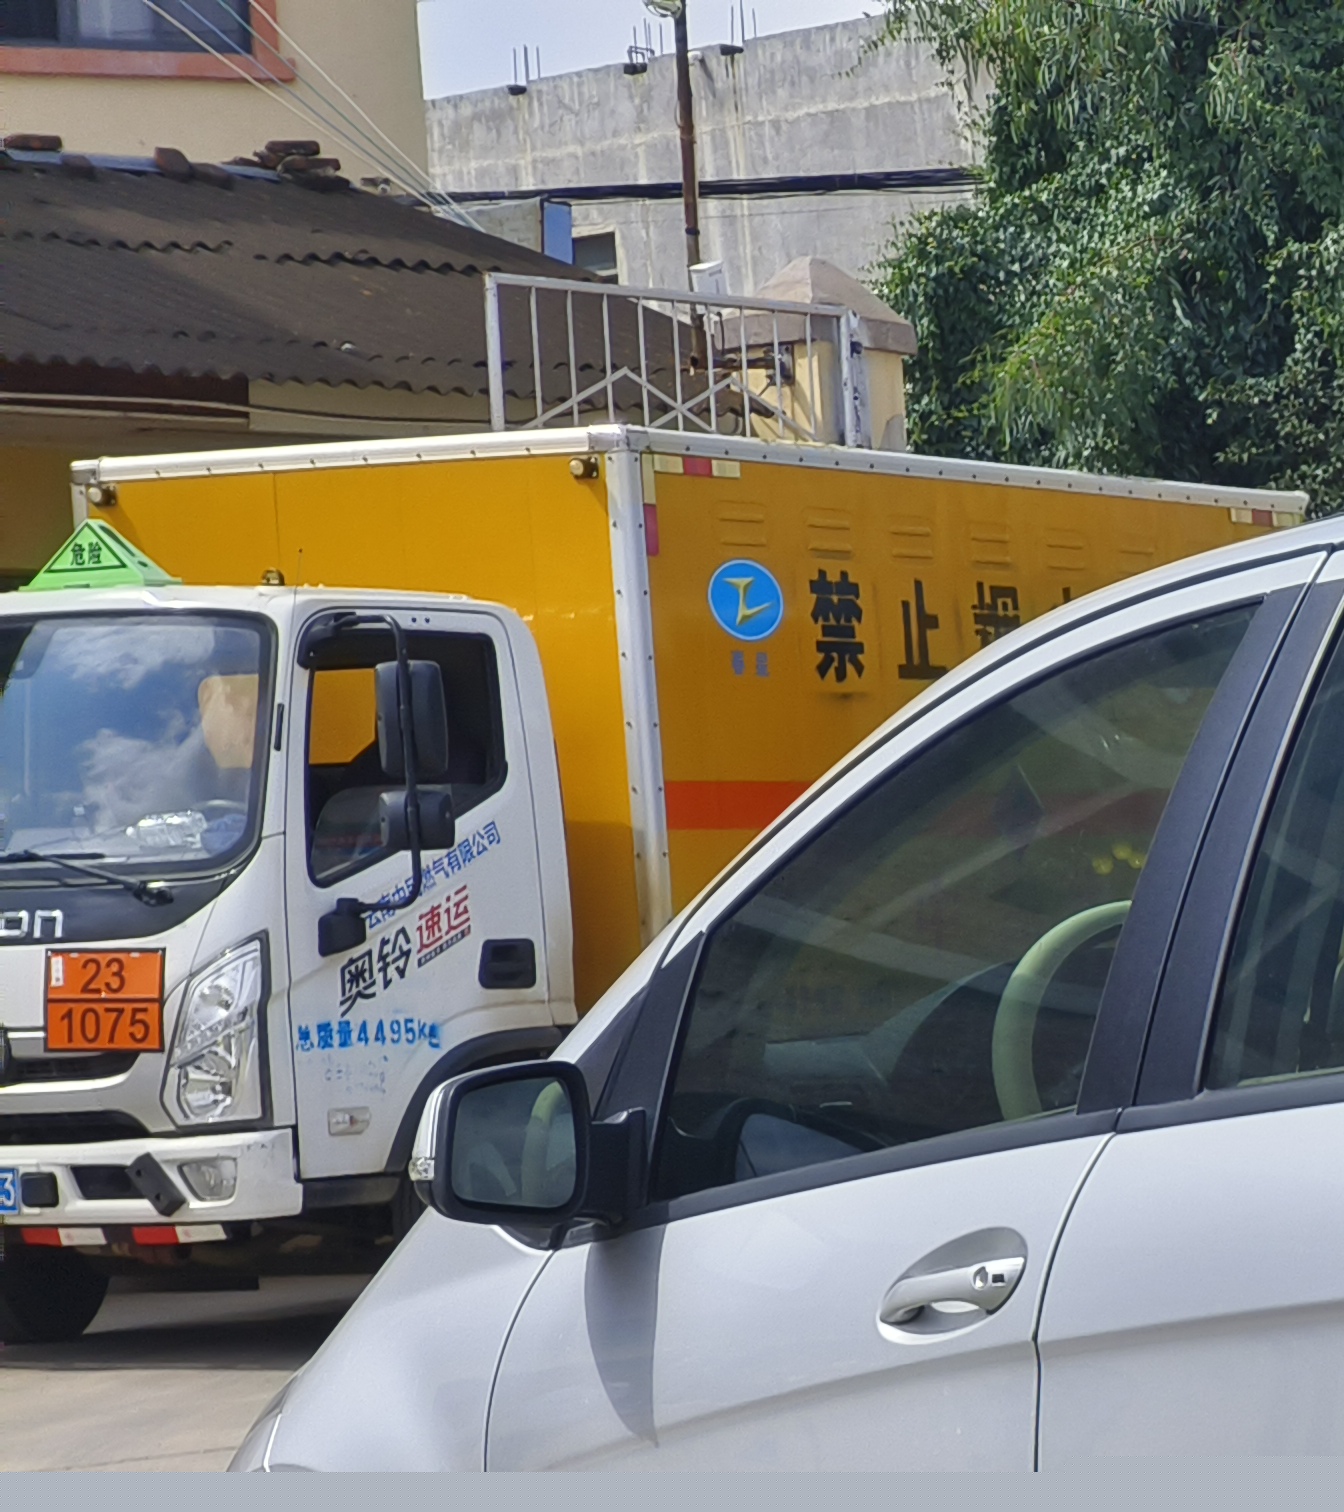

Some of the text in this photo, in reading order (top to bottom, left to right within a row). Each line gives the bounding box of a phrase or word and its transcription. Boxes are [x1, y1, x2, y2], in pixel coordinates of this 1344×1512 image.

[70, 541, 103, 566] 危险
[80, 957, 126, 994] 23
[59, 1006, 151, 1045] 1075
